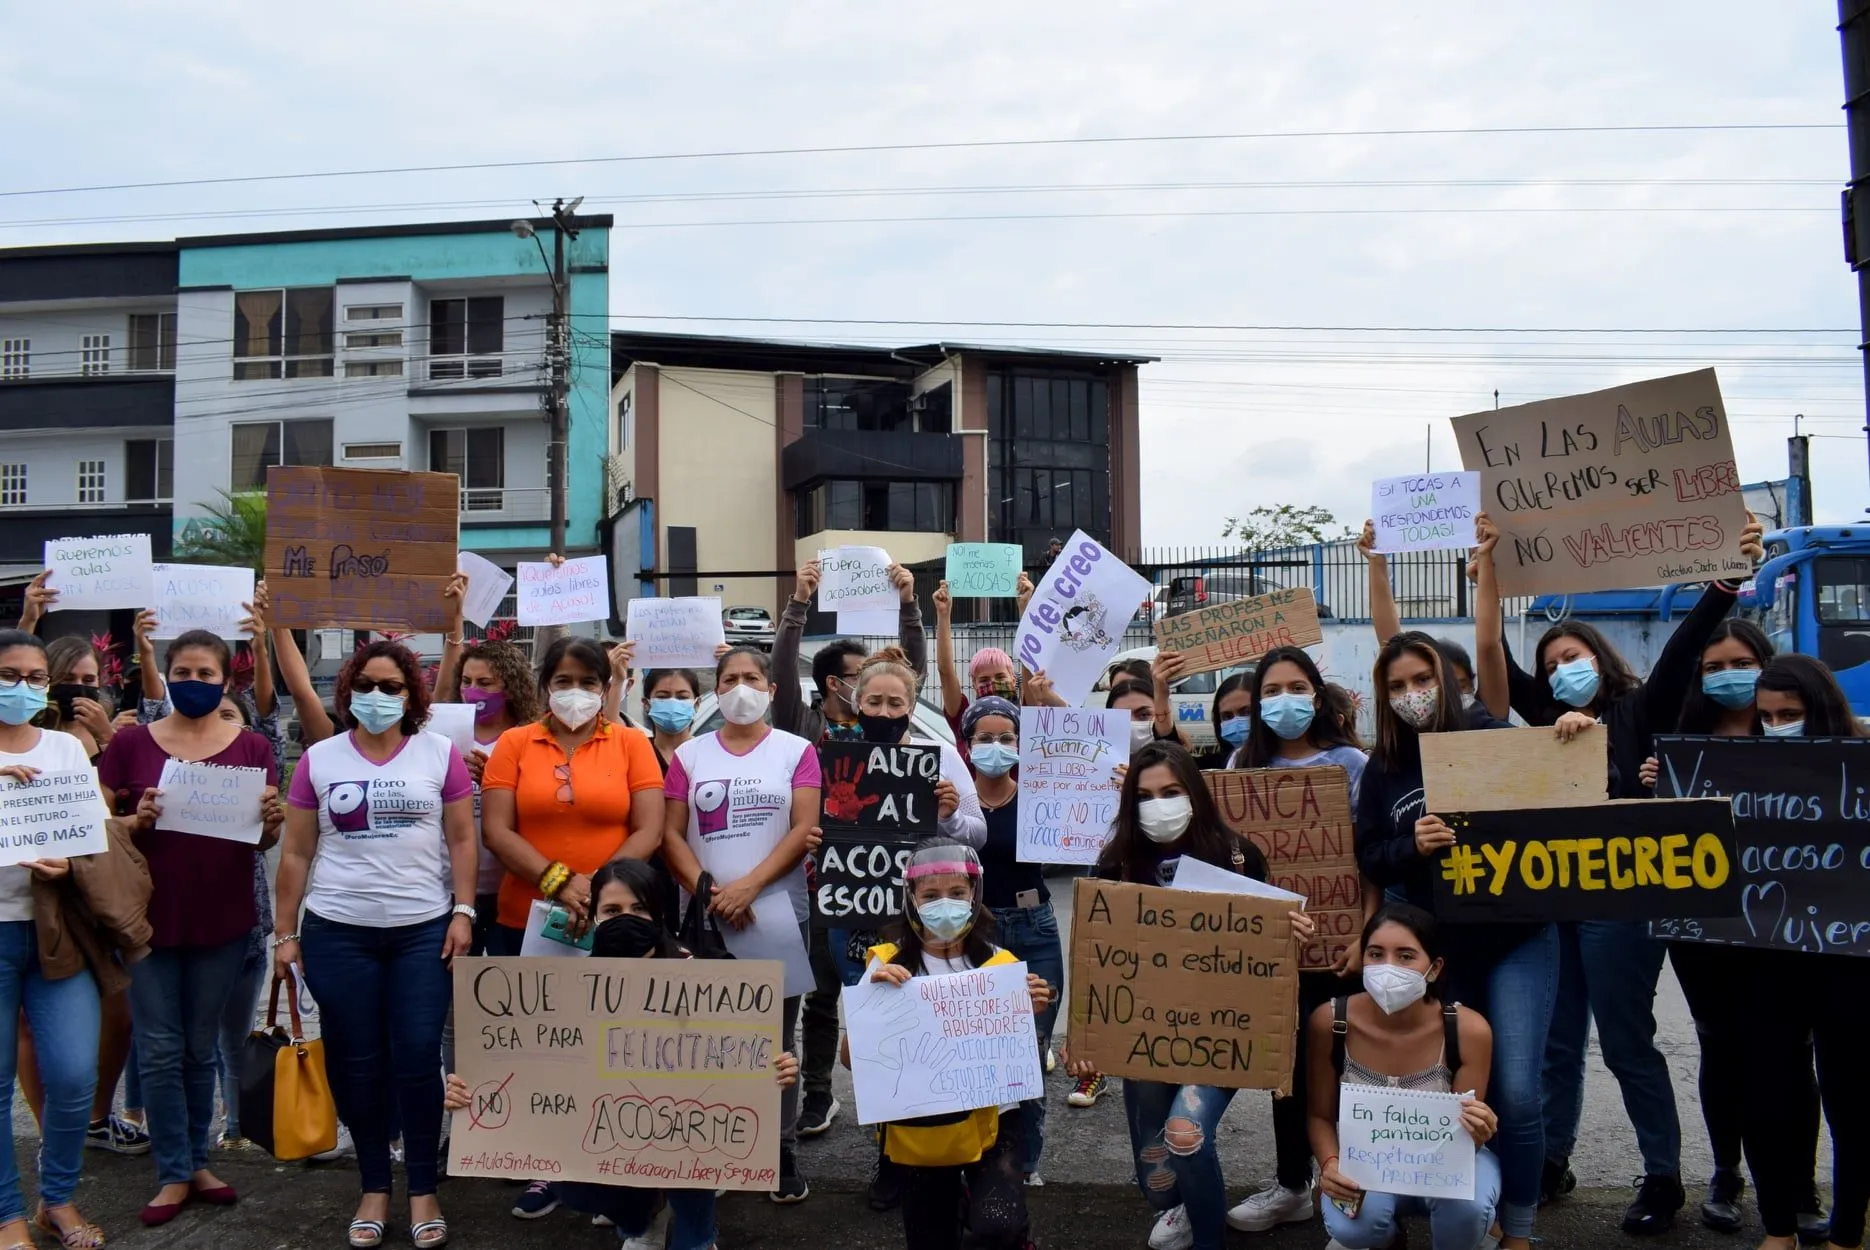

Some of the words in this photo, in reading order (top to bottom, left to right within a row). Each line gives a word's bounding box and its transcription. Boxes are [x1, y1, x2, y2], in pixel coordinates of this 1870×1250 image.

[1541, 421, 1598, 458] LAS
[1613, 404, 1719, 456] AULAS
[1379, 484, 1394, 497] SI
[1401, 478, 1444, 493] TOCAS
[1450, 477, 1462, 489] A
[1496, 465, 1617, 512] QUEREMOS
[1625, 468, 1669, 497] SER
[1411, 492, 1437, 509] UNA
[1380, 505, 1471, 528] RESPONDEMOS
[1397, 522, 1455, 543] TODAS!
[1513, 535, 1554, 567] NO
[1562, 515, 1725, 568] VALIENTES
[55, 545, 133, 562] Queremos
[283, 545, 317, 578] ME
[822, 557, 861, 572] Fuera
[71, 562, 112, 577] aulas
[531, 581, 561, 597] aulas
[569, 577, 599, 593] libres
[963, 571, 1012, 592] ACOSAS
[1020, 633, 1042, 673] yo
[1053, 541, 1102, 599] creo
[1160, 616, 1192, 636] LAS
[1200, 599, 1264, 627] PROFES
[1269, 590, 1296, 606] ME
[1164, 615, 1266, 652] ENSEÑARON
[1274, 611, 1286, 624] A
[1205, 627, 1298, 664] LUCHAR
[1035, 708, 1055, 736] NO
[1087, 713, 1105, 737] UN
[54, 775, 72, 787] FUI
[74, 773, 89, 784] YO
[169, 767, 207, 784] Alto
[222, 776, 239, 789] al
[1059, 762, 1086, 777] LOBO
[372, 778, 406, 789] foro
[734, 777, 762, 787] foro
[1023, 780, 1049, 794] sigue
[1053, 781, 1071, 795] por
[3, 794, 55, 808] PRESENTE
[57, 792, 73, 804] MI
[75, 790, 97, 801] HIJA
[373, 790, 385, 798] de
[373, 799, 434, 811] mujeres
[733, 793, 786, 807] mujeres
[10, 815, 22, 826] EL
[24, 810, 69, 825] FUTURO
[877, 793, 921, 823] AL
[1067, 802, 1089, 824] NO
[13, 830, 48, 847] UN@
[822, 845, 911, 886] ACOS
[1441, 833, 1729, 896] #YOTECREO
[1742, 843, 1845, 873] acoso
[817, 884, 903, 917] ESCOL
[1088, 889, 1112, 925] A
[1136, 892, 1177, 928] las
[1190, 902, 1264, 935] aulas
[1095, 943, 1139, 980] Voy
[1152, 953, 1168, 968] a
[1183, 945, 1281, 978] estudiar
[473, 966, 556, 1017] QUE
[583, 973, 624, 1014] TU
[644, 977, 774, 1017] LLAMADO
[920, 972, 995, 1001] QUEREMOS
[933, 998, 1010, 1019] PROFESORES
[1088, 984, 1135, 1024] NO
[1142, 1006, 1156, 1022] a
[1165, 1009, 1201, 1037] que
[1211, 1009, 1250, 1030] me
[943, 1015, 1030, 1038] ABUSADORES
[481, 1025, 523, 1050] SEA
[537, 1024, 584, 1048] PARA
[607, 1027, 773, 1072] FELICITARME
[1028, 1036, 1037, 1060] A
[1127, 1031, 1253, 1071] ACOSEN
[941, 1065, 998, 1090] ESTUDIAR
[1025, 1063, 1035, 1084] A
[479, 1092, 503, 1116] NO
[531, 1092, 577, 1114] PARA
[593, 1100, 746, 1145] ACOSARME
[1353, 1103, 1373, 1121] En
[1382, 1105, 1429, 1125] falda
[1440, 1116, 1450, 1126] o
[1371, 1127, 1453, 1143] pantalón
[1382, 1168, 1468, 1186] PROFESOR
